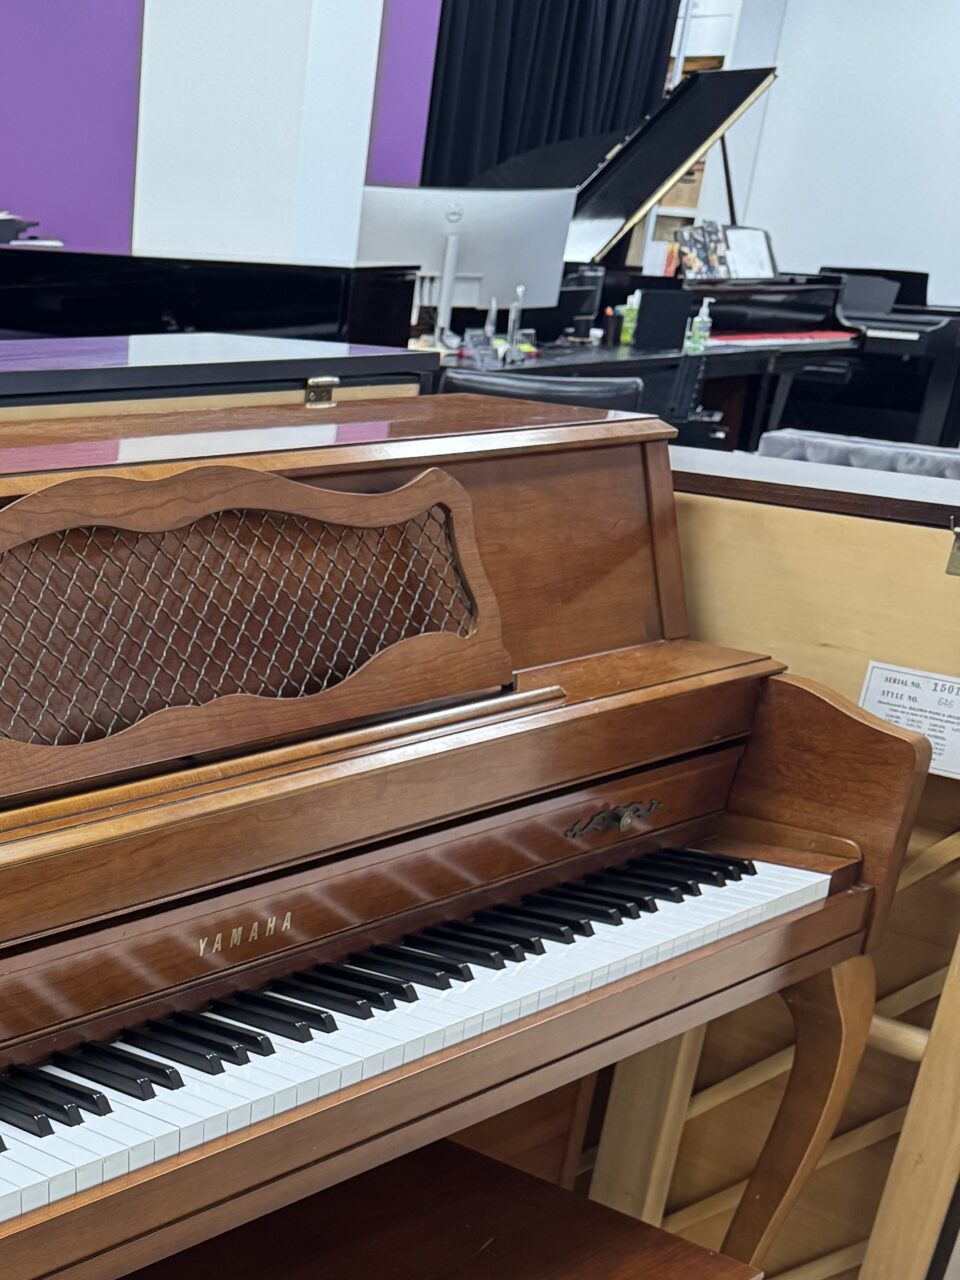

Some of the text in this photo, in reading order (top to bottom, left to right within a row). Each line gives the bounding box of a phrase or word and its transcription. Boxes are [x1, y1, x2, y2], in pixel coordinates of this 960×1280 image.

[884, 676, 908, 687] SERIAL
[910, 681, 922, 690] NO.
[881, 690, 904, 700] STYLE
[908, 695, 919, 703] NO.
[199, 911, 292, 957] YAMAHA
